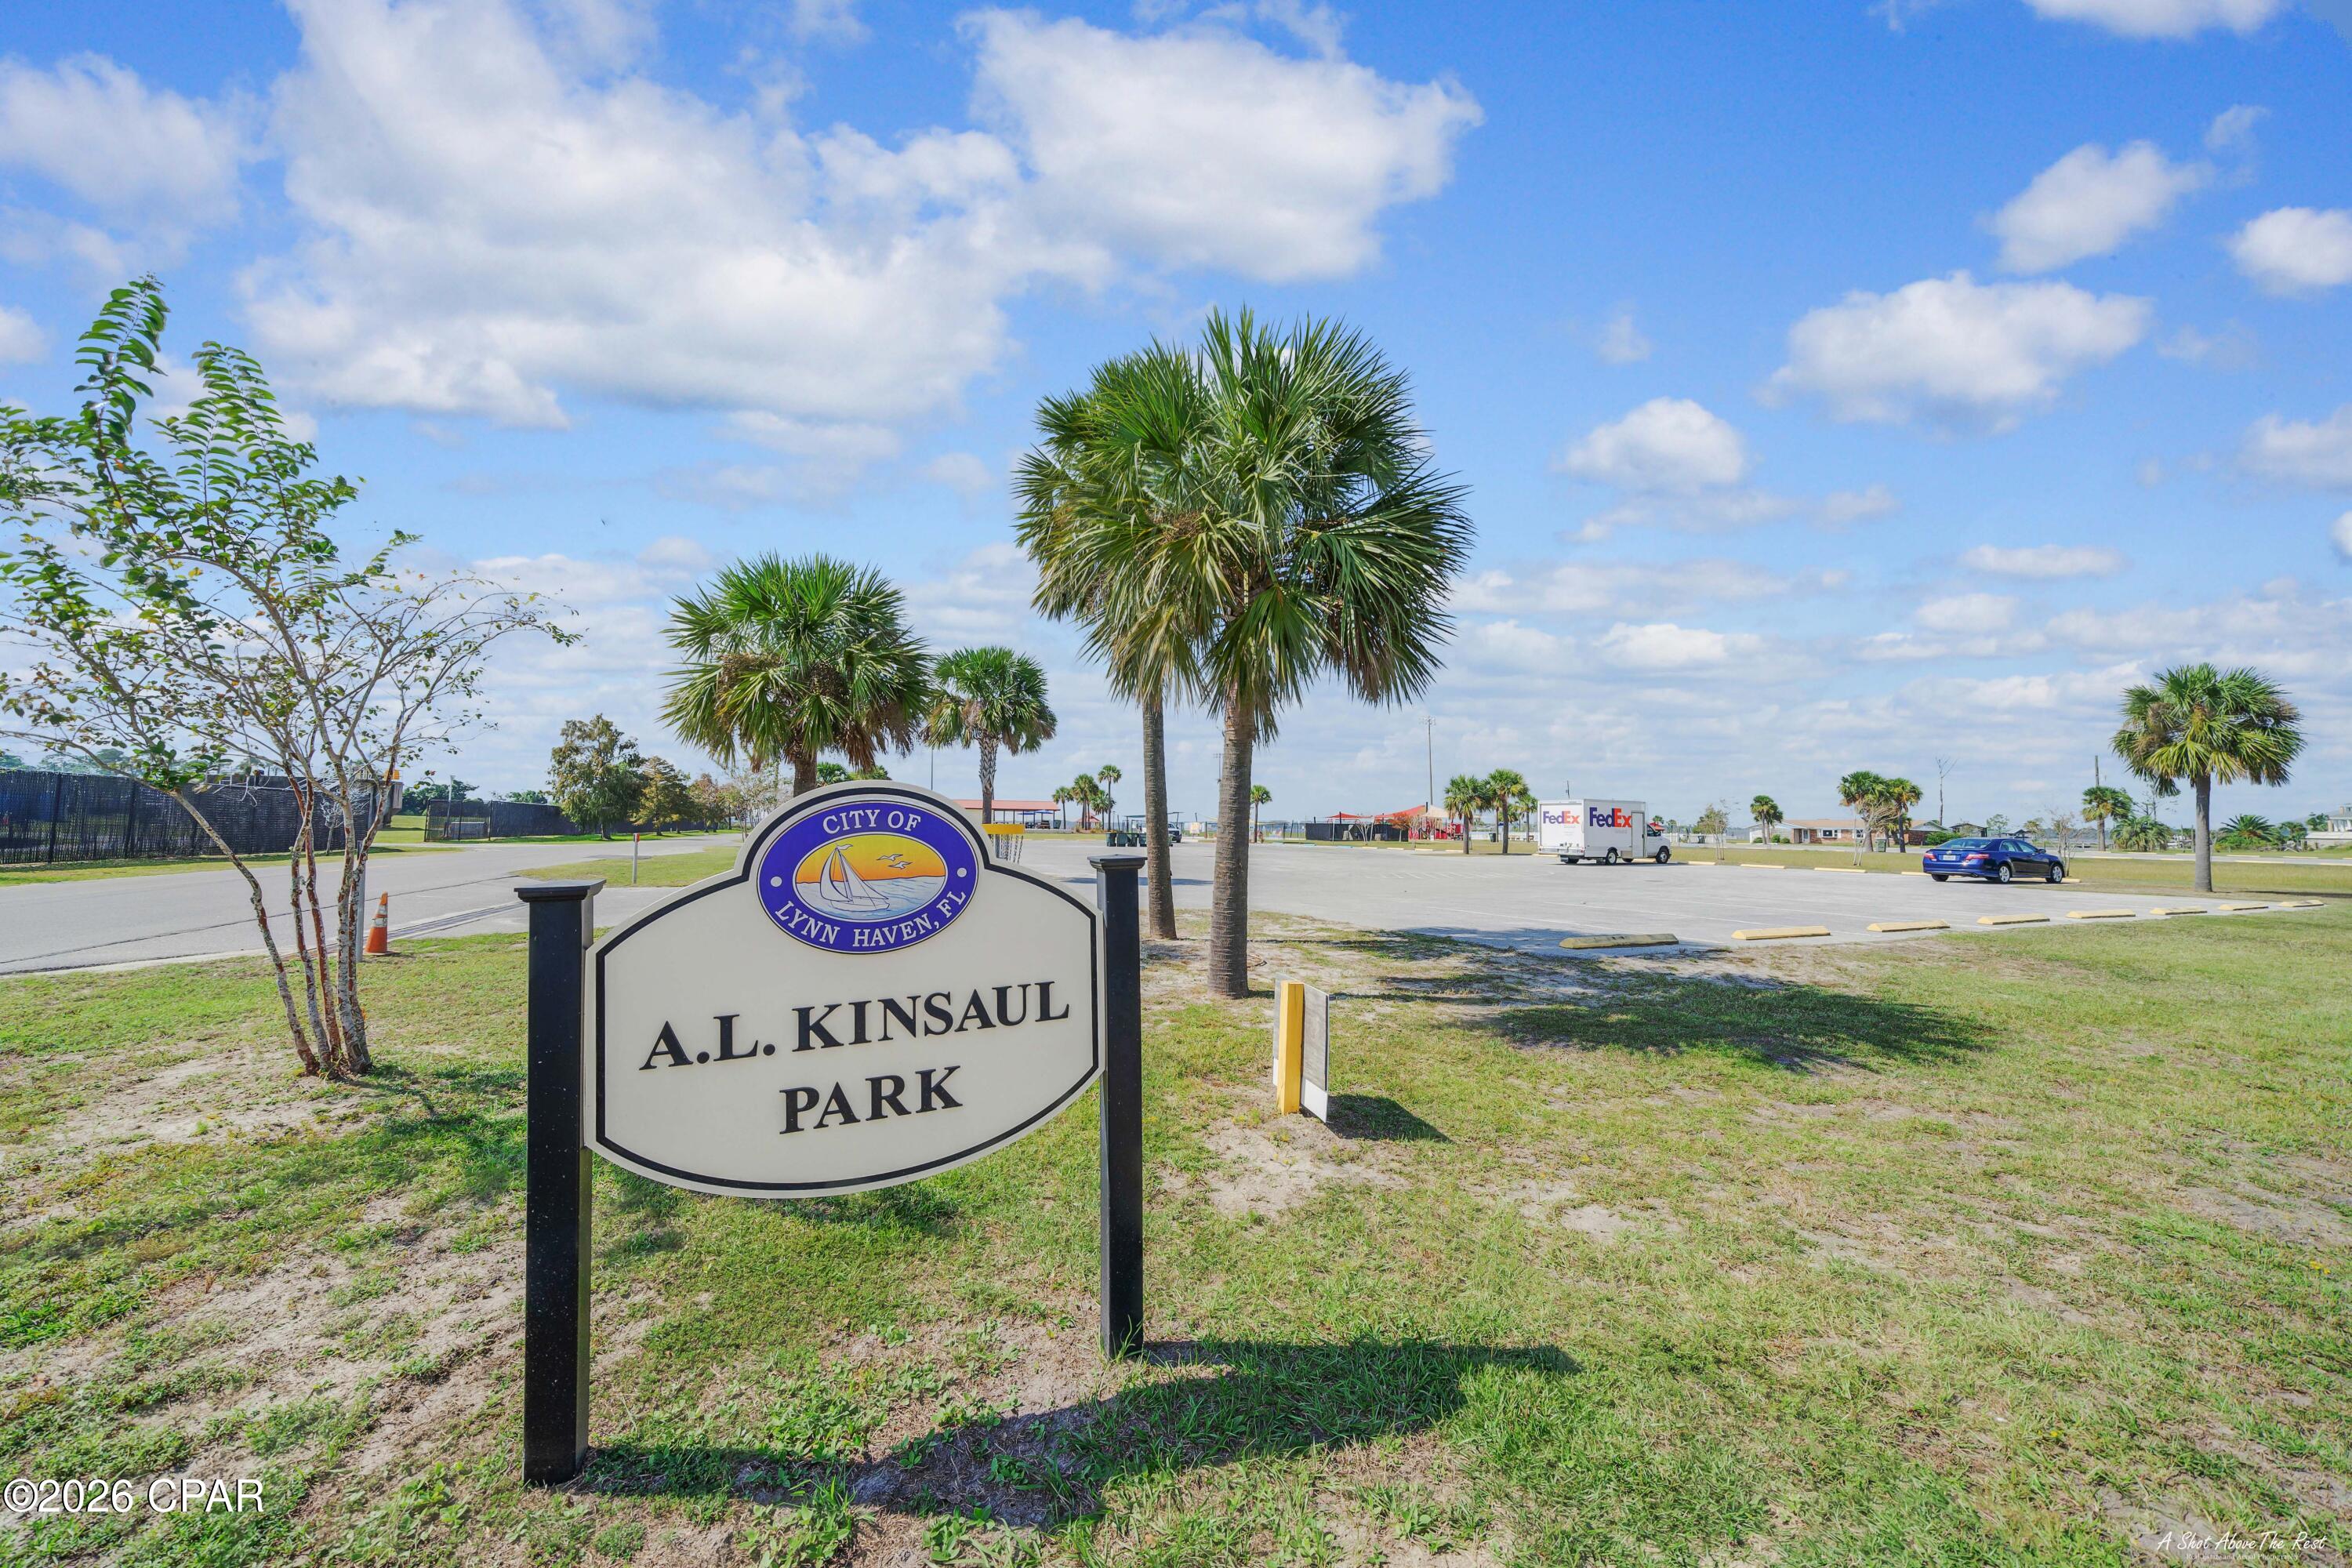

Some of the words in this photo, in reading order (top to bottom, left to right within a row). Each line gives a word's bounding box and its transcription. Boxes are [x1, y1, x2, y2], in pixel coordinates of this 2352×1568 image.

[823, 809, 880, 834] CITY
[887, 811, 921, 832] OF
[1543, 811, 1580, 824] FedEx
[1589, 807, 1632, 828] FedEx
[775, 901, 840, 945] LYNN
[852, 913, 940, 947] HAVEN,
[936, 891, 966, 919] FL
[639, 1014, 776, 1070] A.L.
[791, 981, 1070, 1053] KINSAUL
[779, 1065, 964, 1134] PARK
